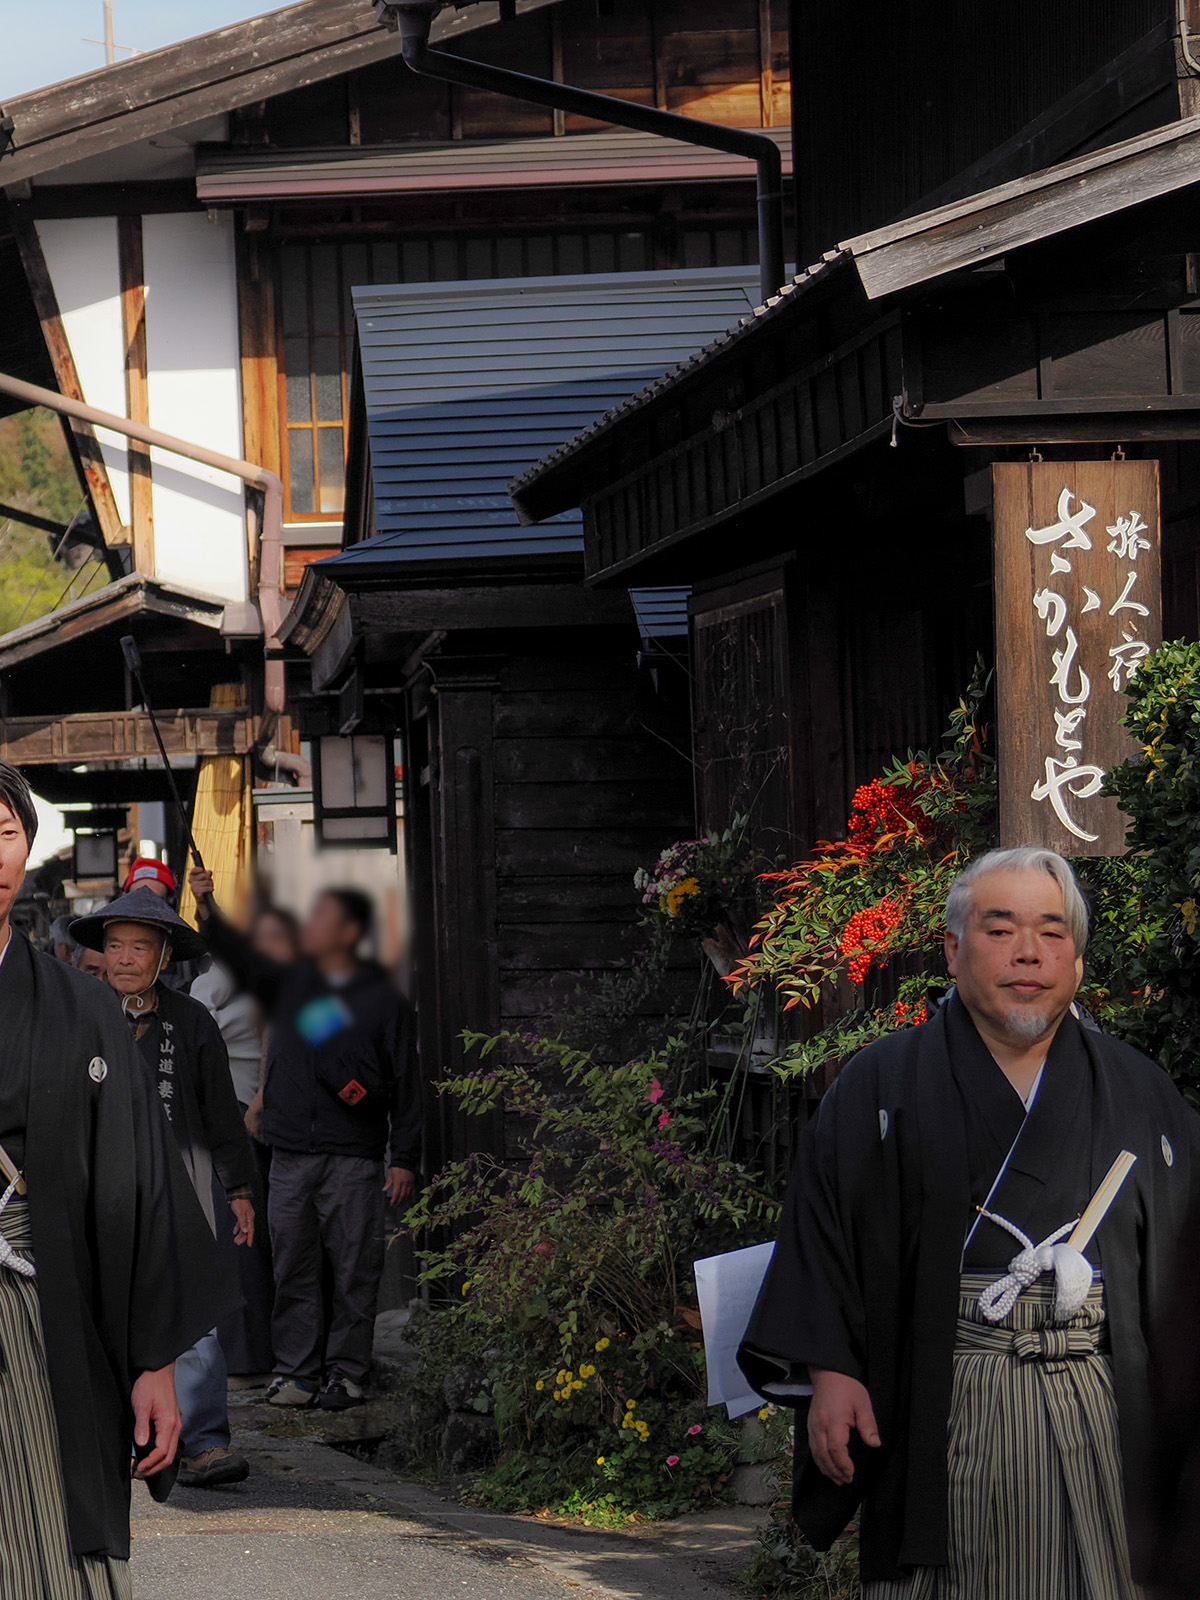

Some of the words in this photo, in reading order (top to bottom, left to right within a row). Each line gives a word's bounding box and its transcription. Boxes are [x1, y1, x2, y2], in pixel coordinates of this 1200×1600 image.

[1025, 487, 1104, 842] さかもとや
[1106, 510, 1150, 692] 旅人宿
